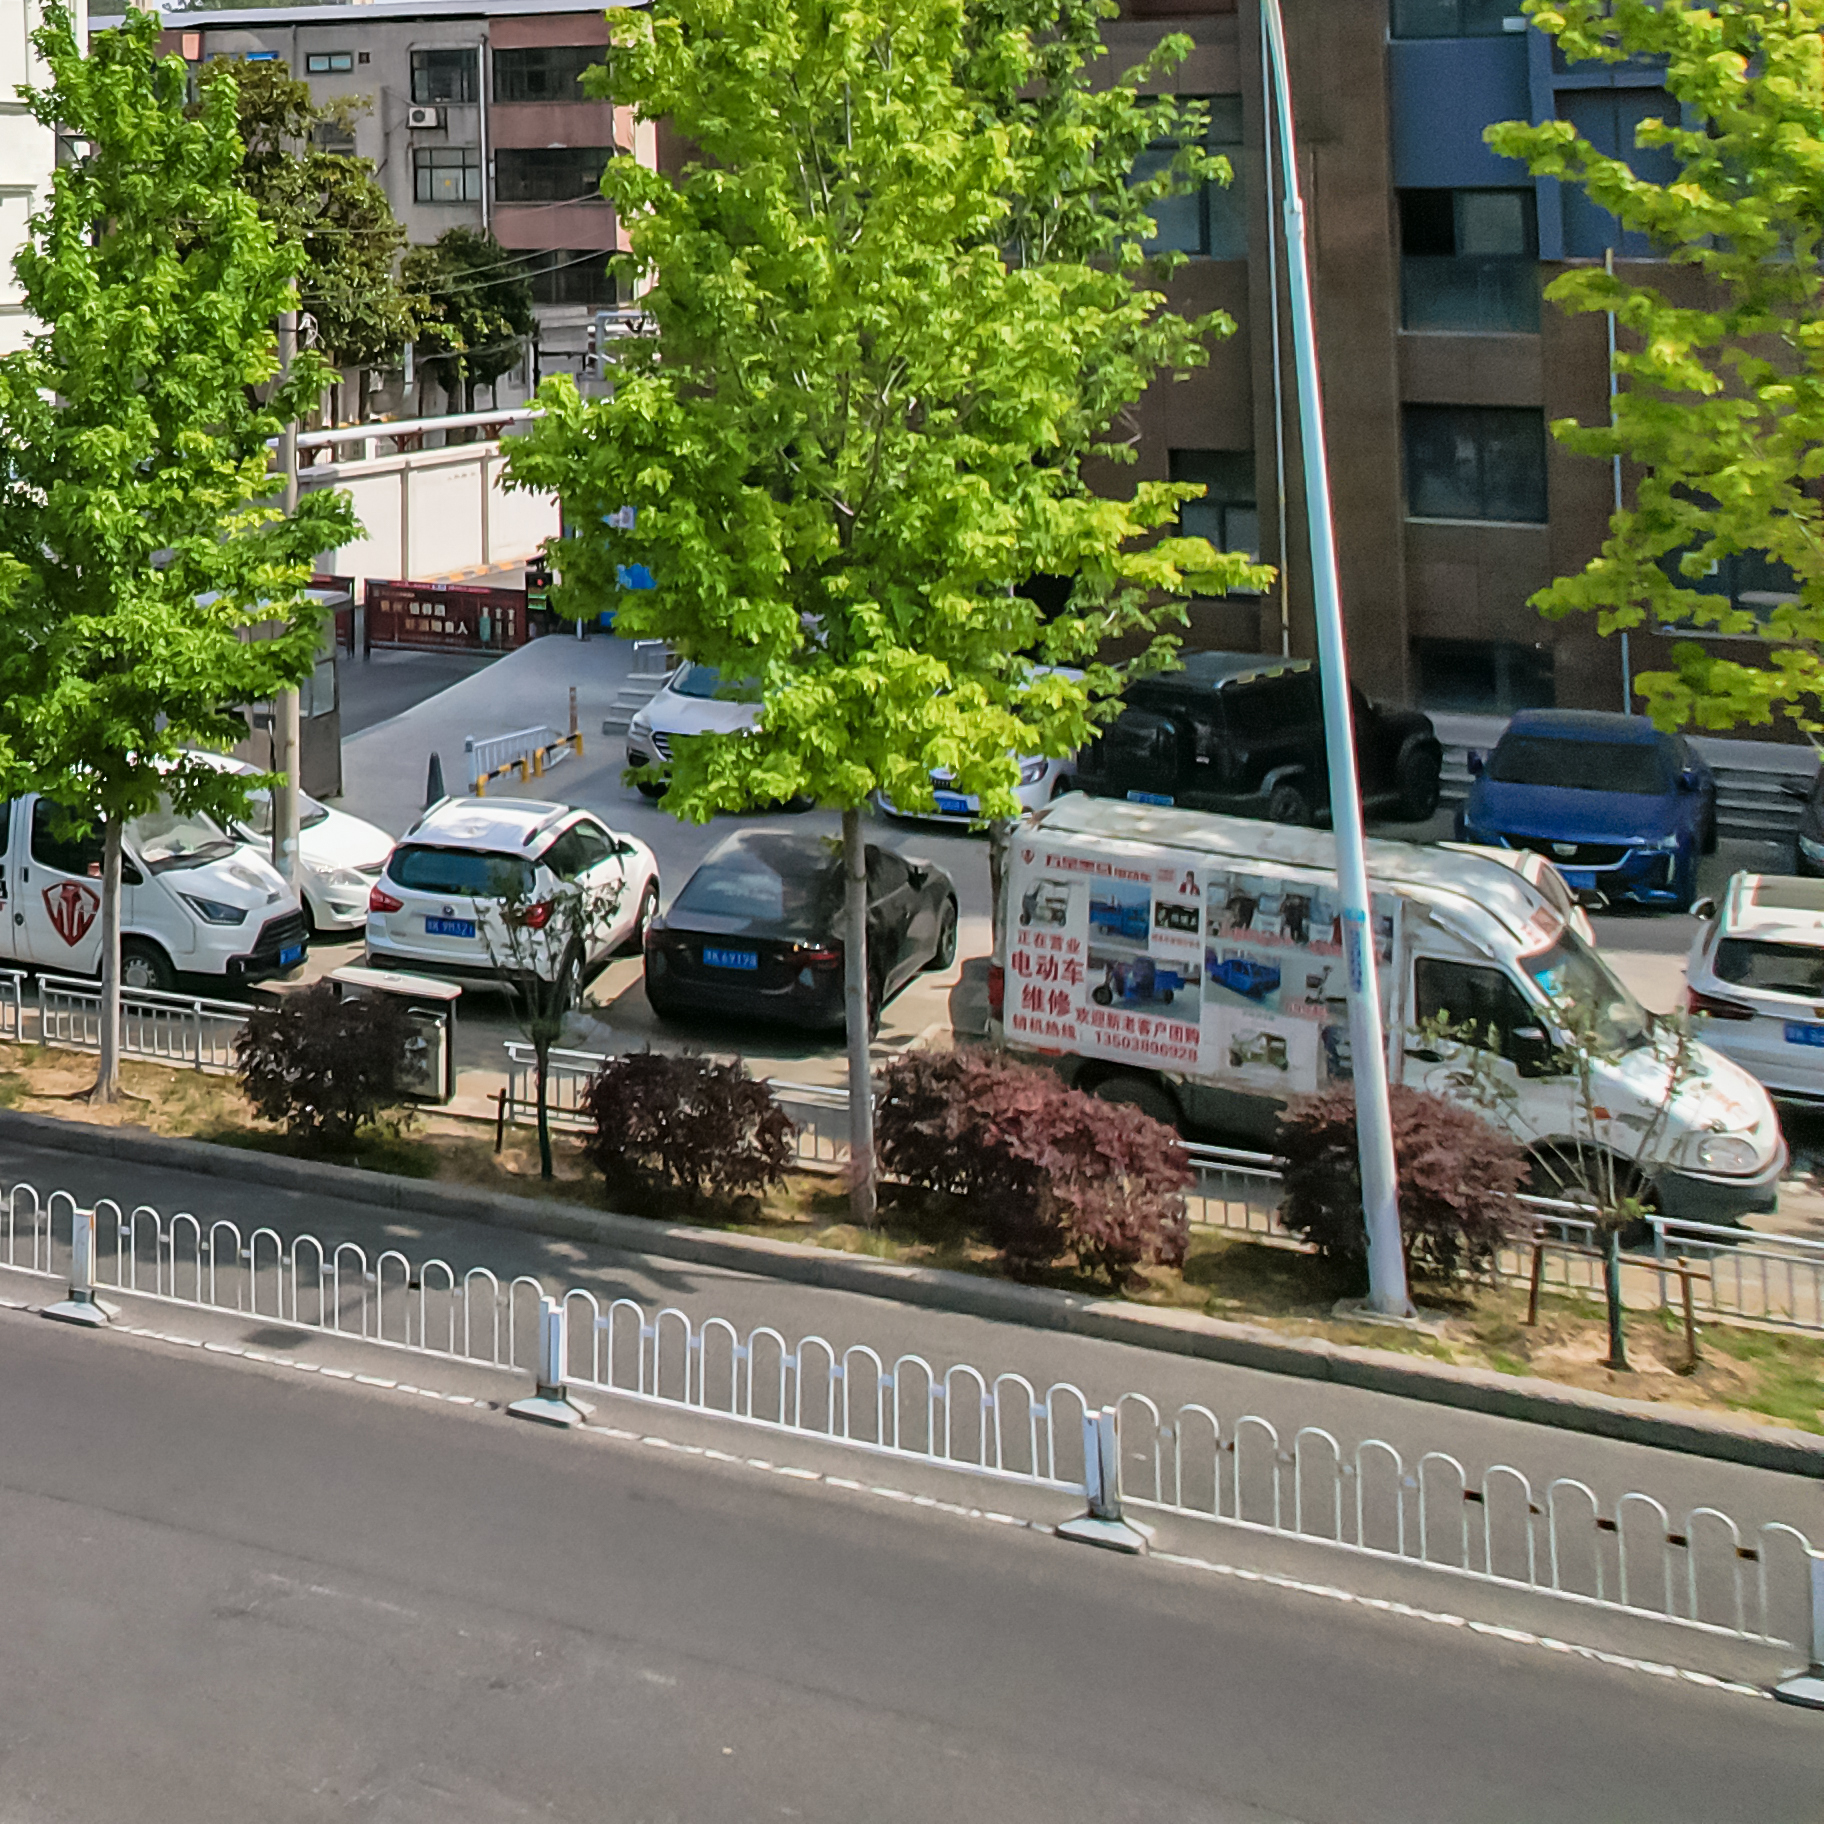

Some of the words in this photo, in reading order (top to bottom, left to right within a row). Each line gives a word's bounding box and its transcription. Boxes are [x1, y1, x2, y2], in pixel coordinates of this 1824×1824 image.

[1011, 949, 1084, 986] 电动车
[1021, 983, 1071, 1018] 维修
